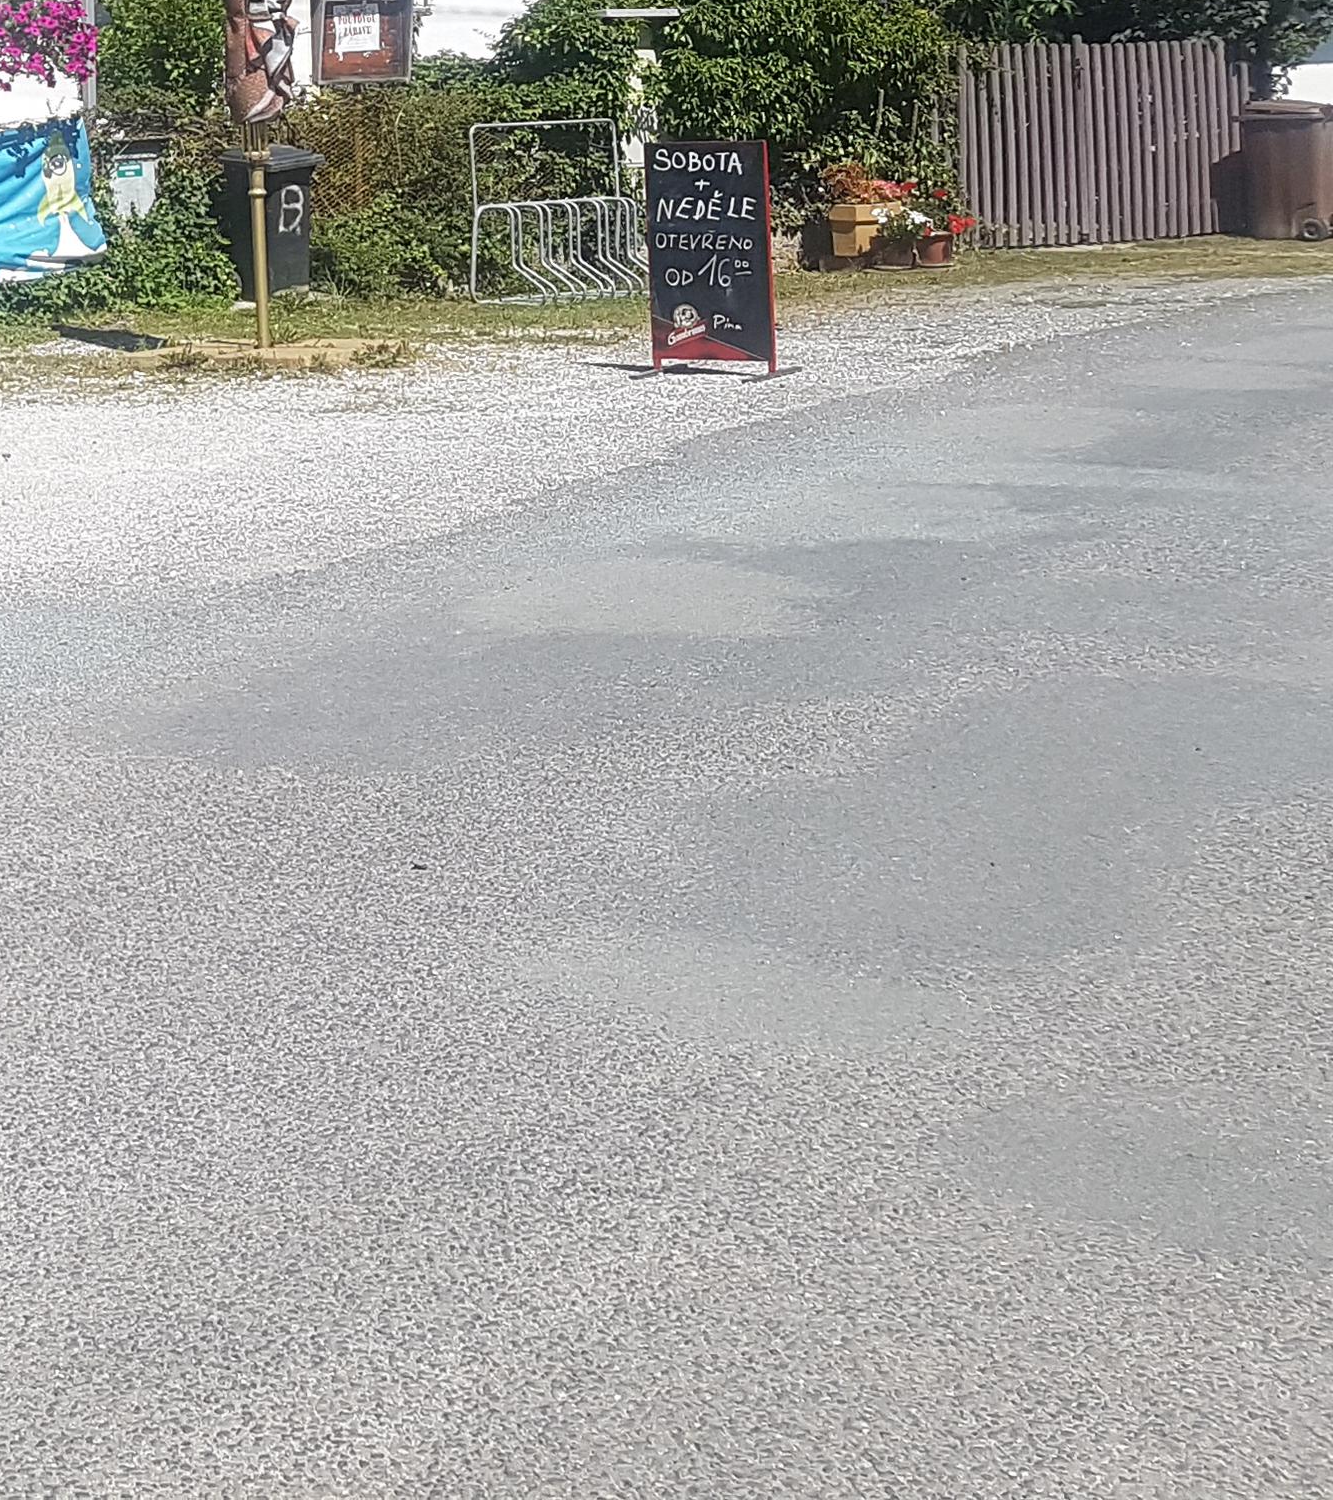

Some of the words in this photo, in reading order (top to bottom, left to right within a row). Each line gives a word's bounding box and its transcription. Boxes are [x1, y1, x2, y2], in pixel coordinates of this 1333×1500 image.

[653, 148, 743, 175] SOBOTA
[656, 189, 757, 222] NEDĚLE
[655, 229, 753, 250] OTEVŘENO
[664, 268, 694, 287] OD
